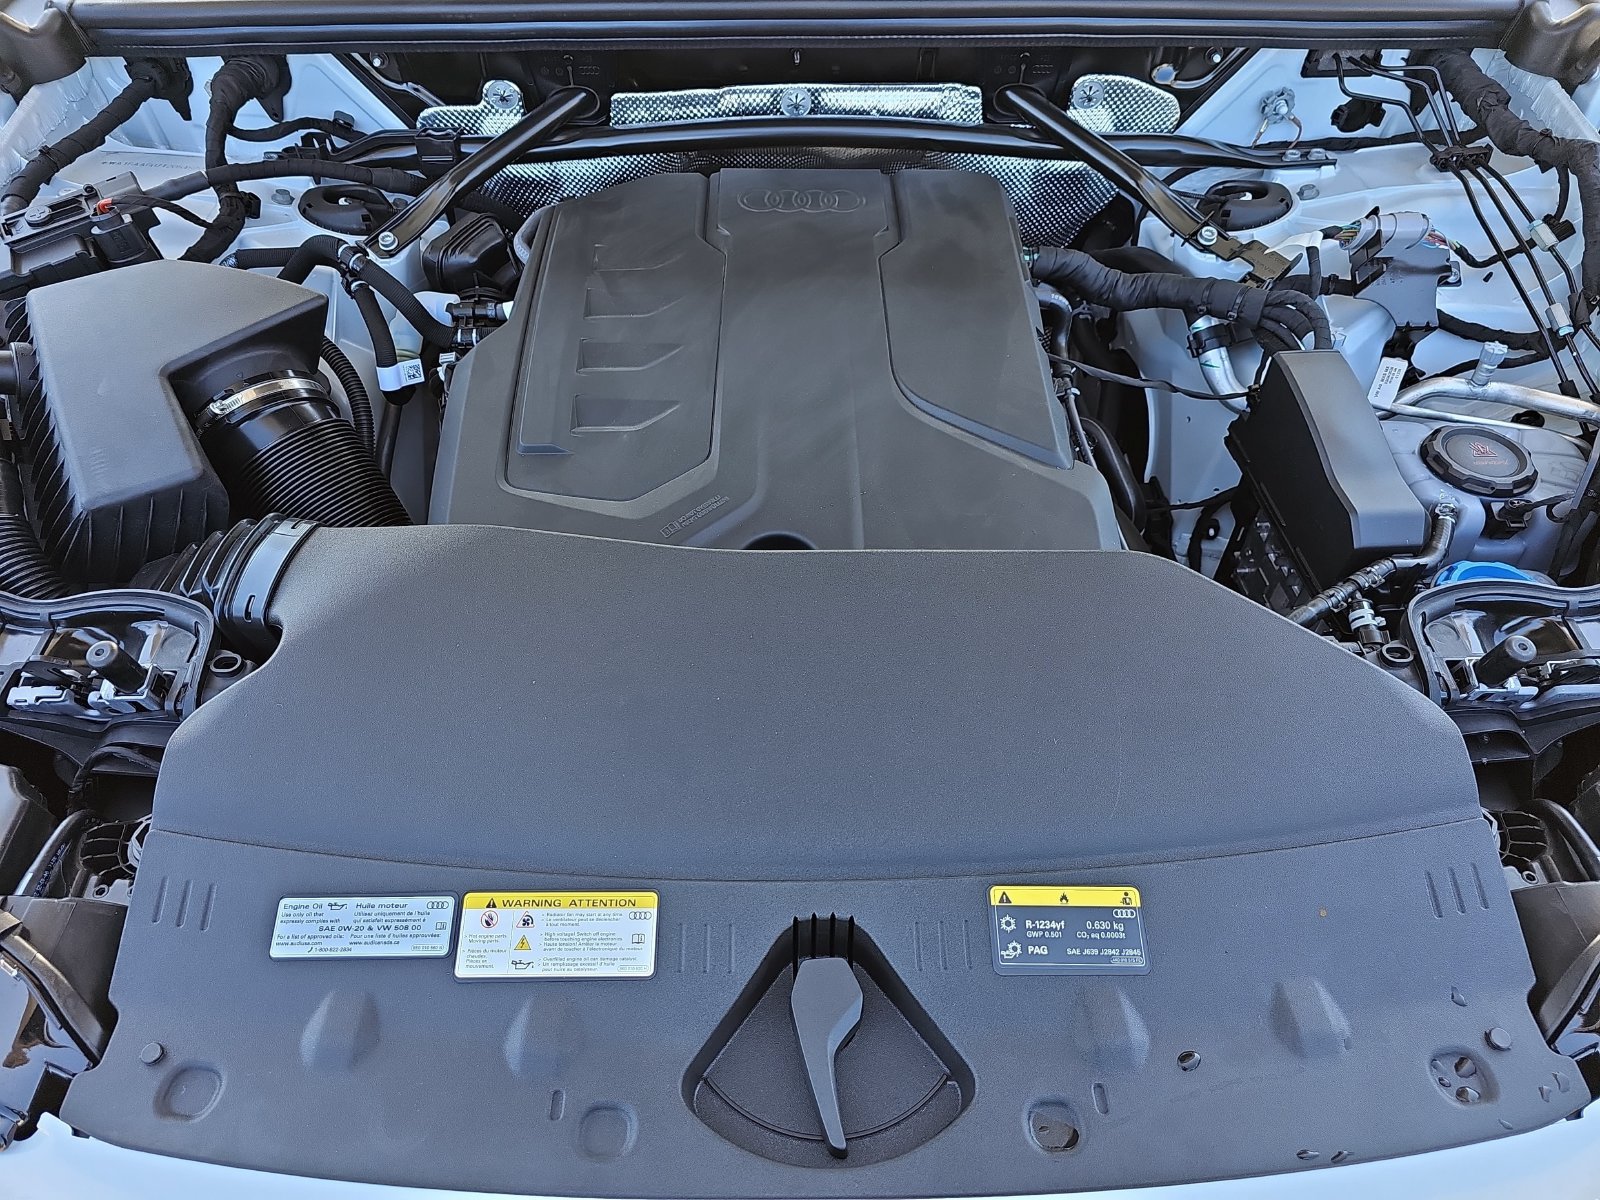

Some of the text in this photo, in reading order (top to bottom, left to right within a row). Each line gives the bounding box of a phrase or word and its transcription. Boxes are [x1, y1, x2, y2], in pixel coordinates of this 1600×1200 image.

[283, 903, 310, 911] Engine
[502, 899, 636, 907] WARNING ATTENTION
[1025, 920, 1124, 931] R-1234yf 0.630 kg
[1028, 945, 1048, 955] PAG
